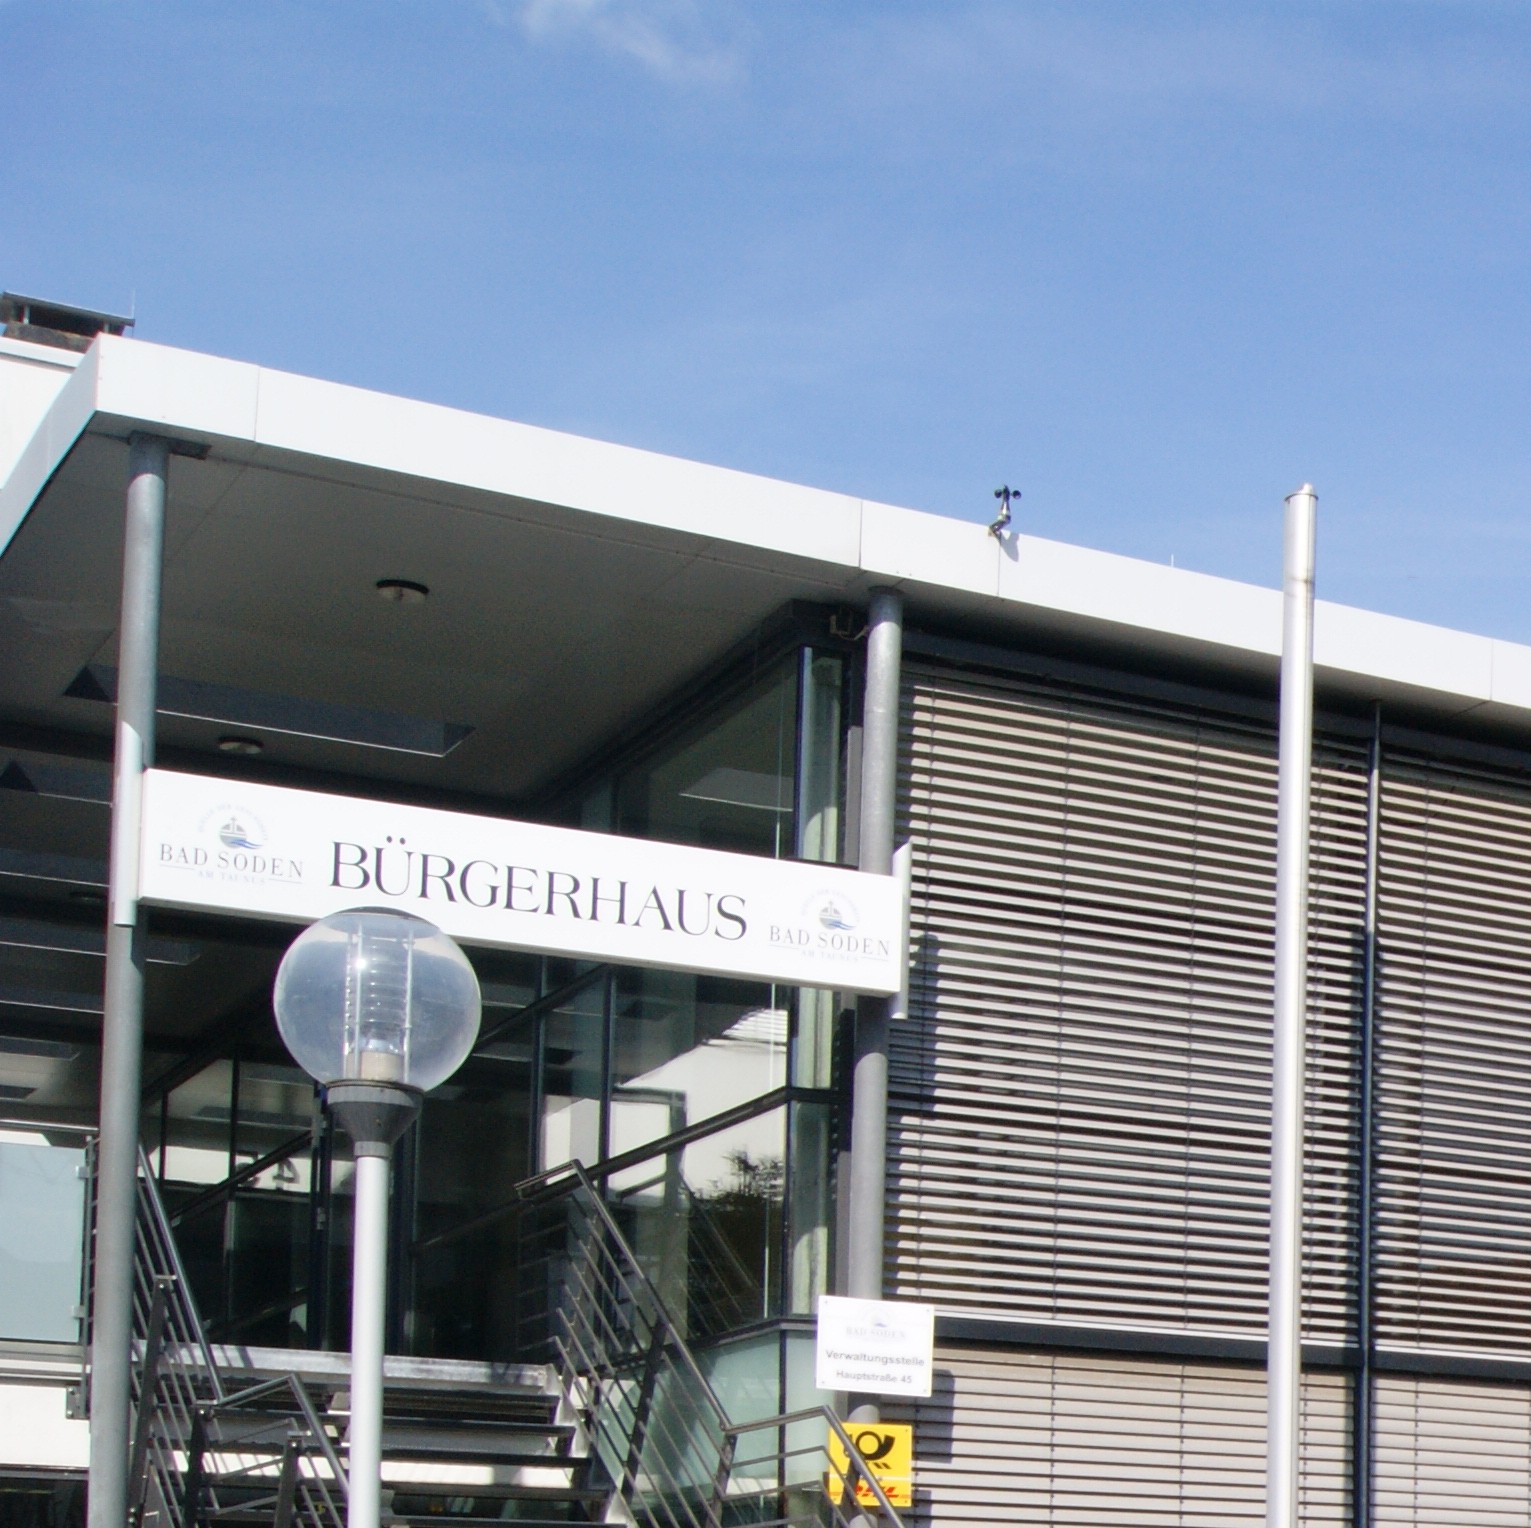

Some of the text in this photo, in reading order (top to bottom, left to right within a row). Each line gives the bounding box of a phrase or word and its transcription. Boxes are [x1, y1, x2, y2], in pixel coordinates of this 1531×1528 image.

[159, 843, 304, 879] BAD SODEN
[329, 836, 748, 942] BÜRGERHAUS
[769, 924, 891, 957] BAD SODEN
[846, 1327, 867, 1338] BAD
[870, 1329, 907, 1340] SODEN
[825, 1349, 925, 1367] Verwaltungsstelle
[836, 1369, 913, 1384] Hauptstraße 45
